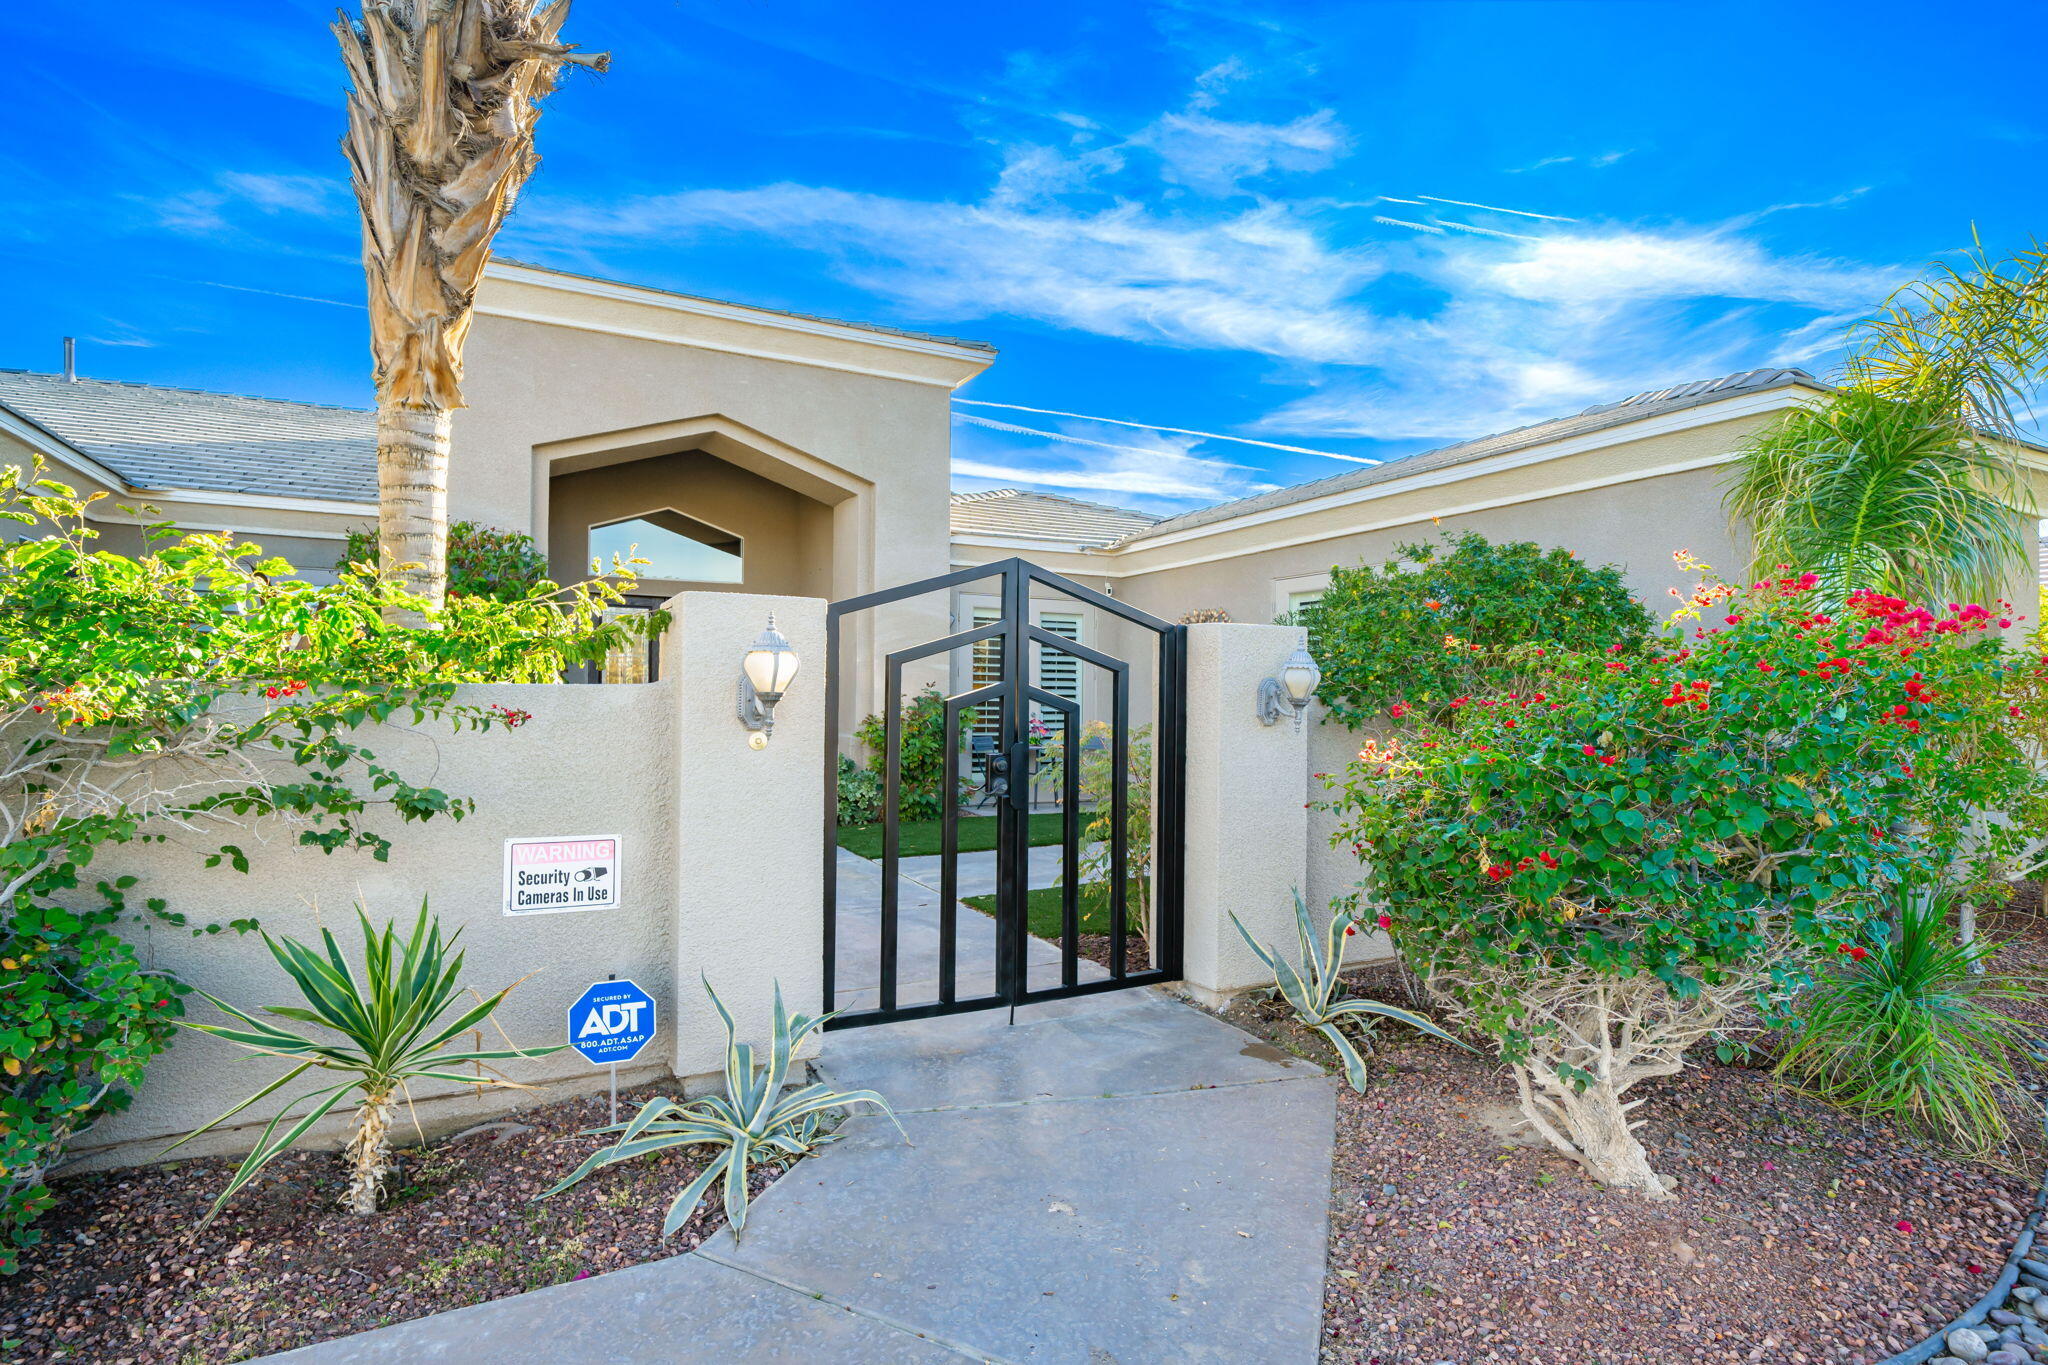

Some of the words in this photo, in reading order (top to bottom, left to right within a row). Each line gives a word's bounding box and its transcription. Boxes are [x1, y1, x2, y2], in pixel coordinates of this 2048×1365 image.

[516, 842, 610, 862] WARNING
[518, 868, 571, 887] Security
[518, 890, 569, 906] Cameras
[573, 887, 584, 902] In
[587, 886, 608, 901] Use
[593, 994, 622, 1003] SECURED
[578, 1001, 647, 1039] ADT
[580, 1034, 645, 1049] 800.ADT.ASAP
[598, 1045, 628, 1054] ADT.COM
